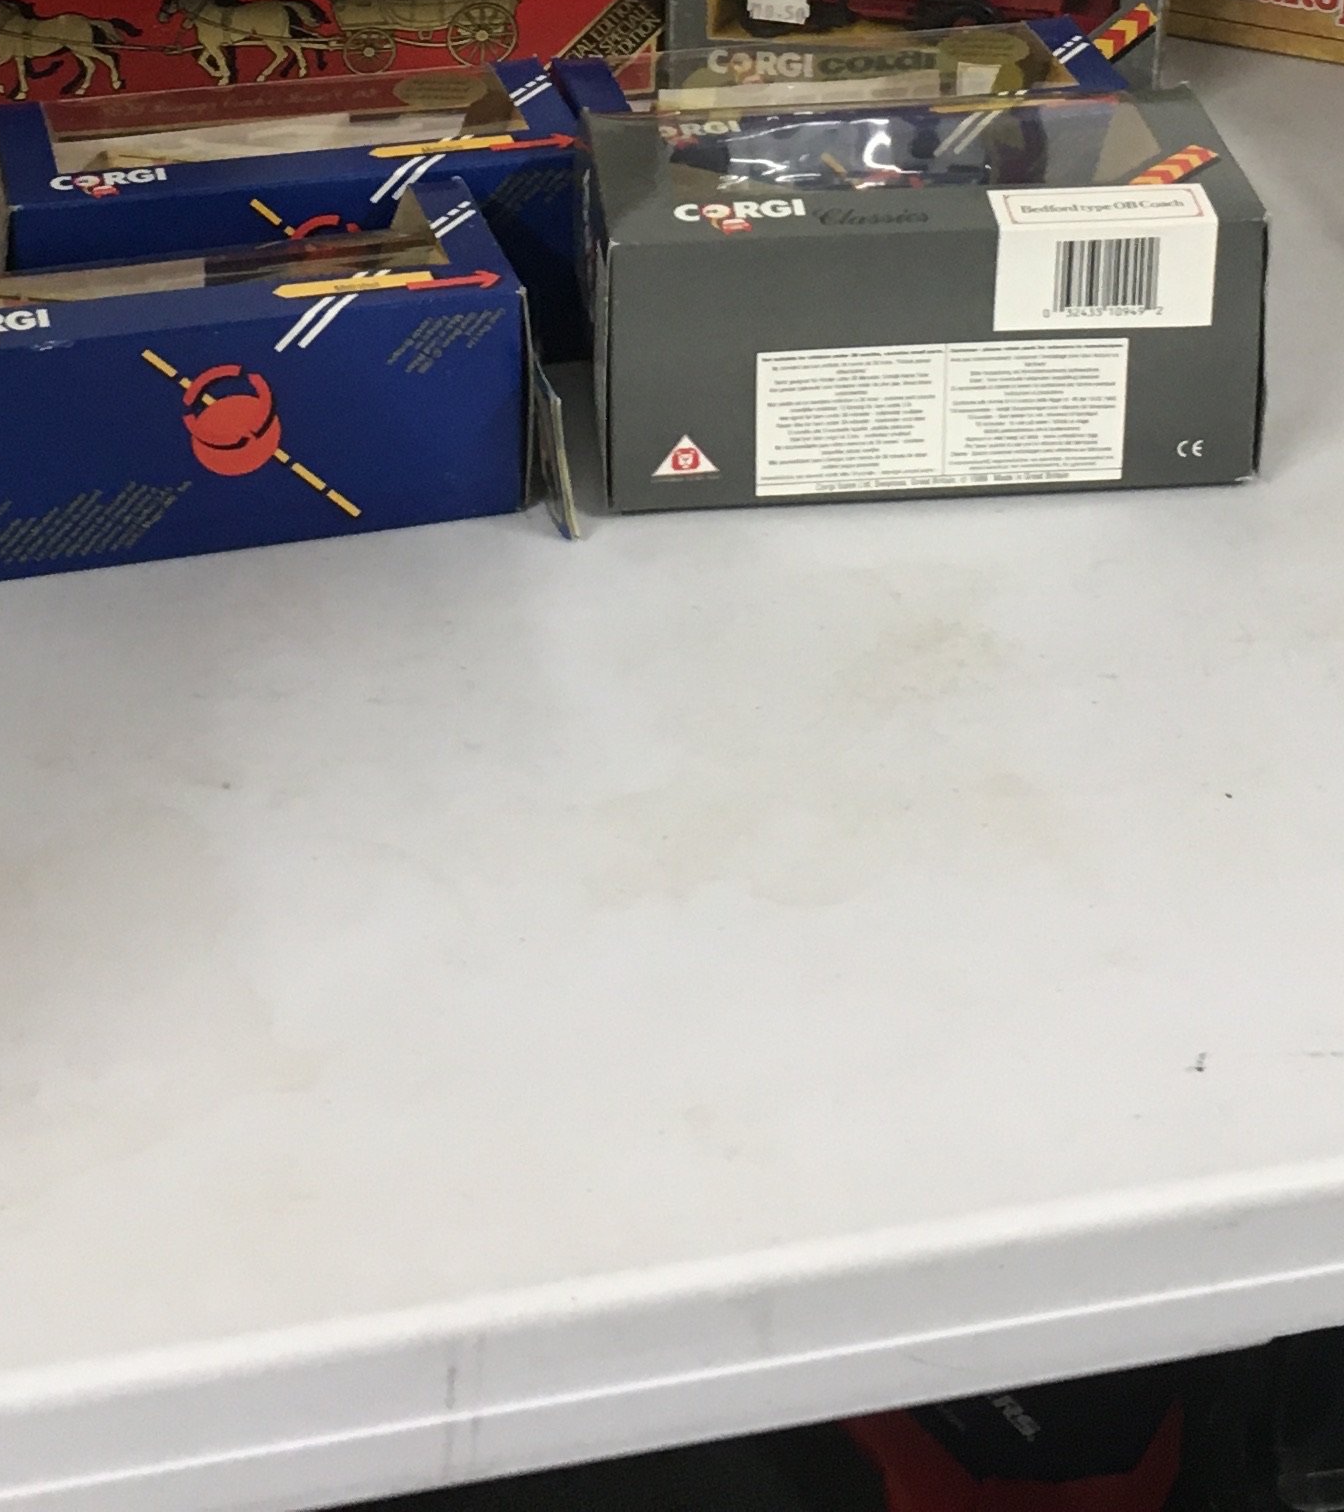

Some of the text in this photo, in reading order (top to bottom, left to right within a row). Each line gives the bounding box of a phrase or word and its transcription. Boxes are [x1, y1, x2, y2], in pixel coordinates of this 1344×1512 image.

[707, 49, 814, 79] CORGI
[49, 166, 168, 192] CORGI
[673, 199, 929, 229] CORGI Classics
[1020, 203, 1079, 214] Bedford
[1113, 201, 1138, 211] OB
[1139, 198, 1185, 210] Coach
